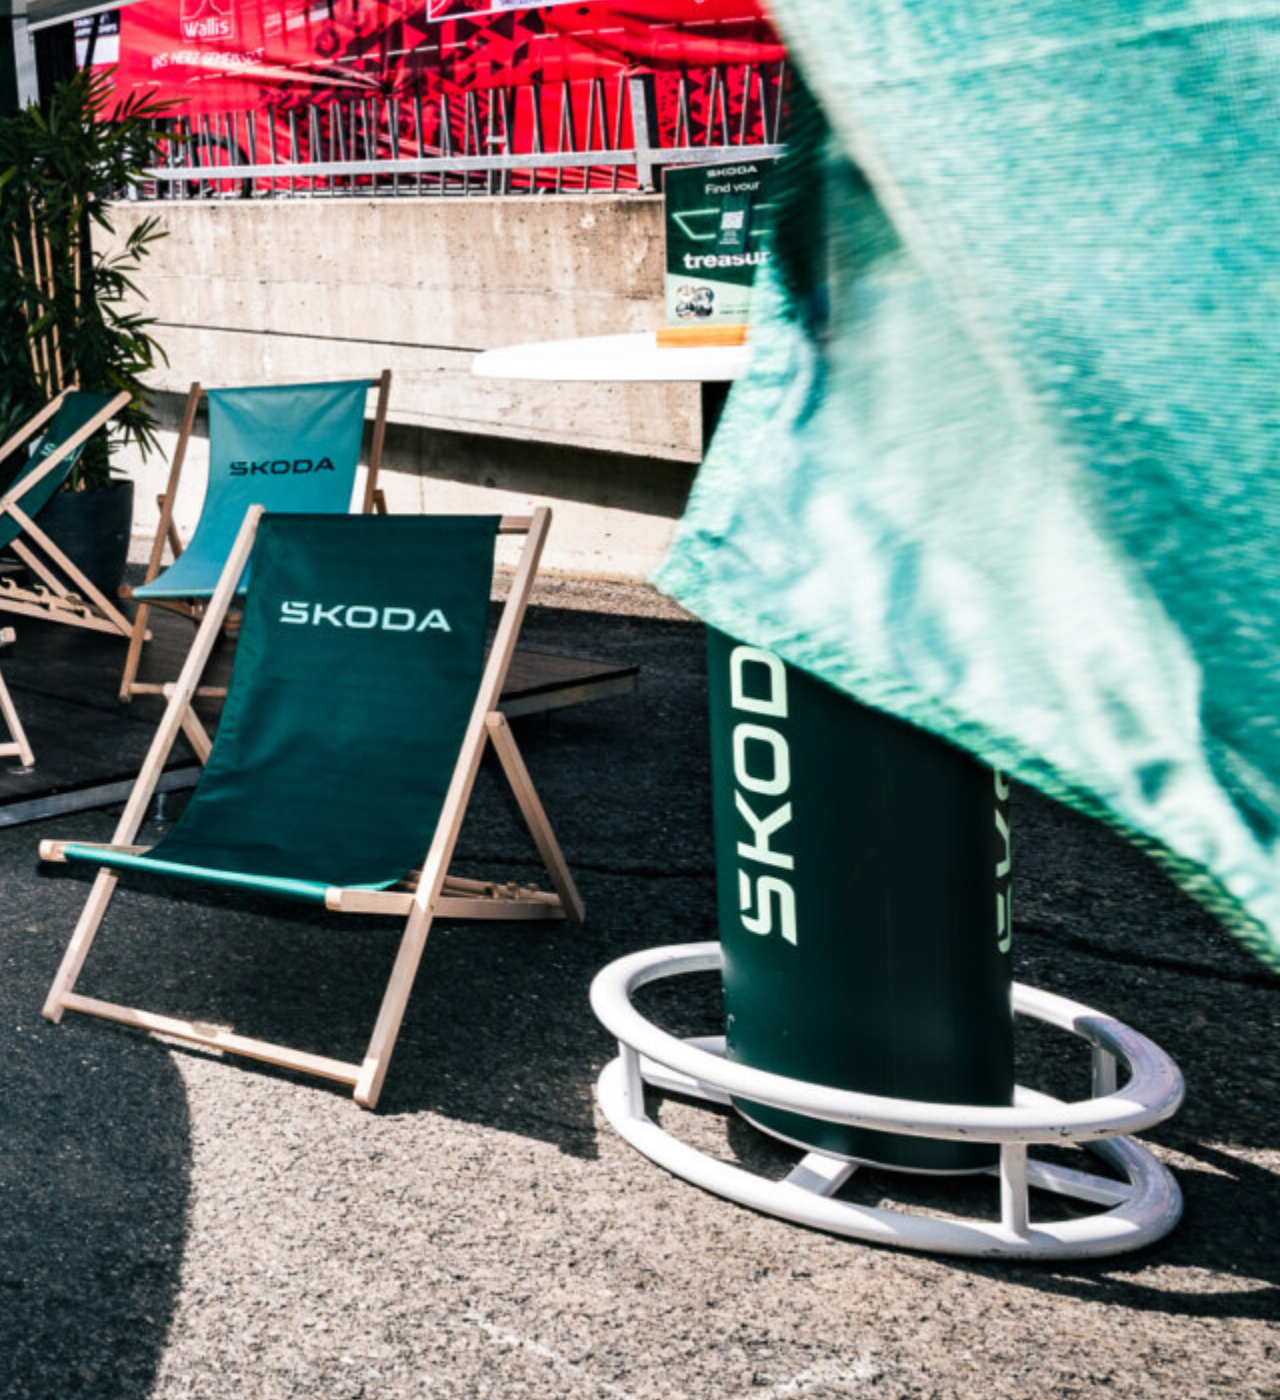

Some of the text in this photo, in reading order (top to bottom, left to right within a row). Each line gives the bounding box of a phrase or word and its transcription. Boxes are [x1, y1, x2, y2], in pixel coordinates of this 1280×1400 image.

[183, 17, 229, 37] Wallis
[705, 181, 760, 195] Find your
[682, 250, 771, 269] treasur
[729, 645, 798, 947] SKOD
